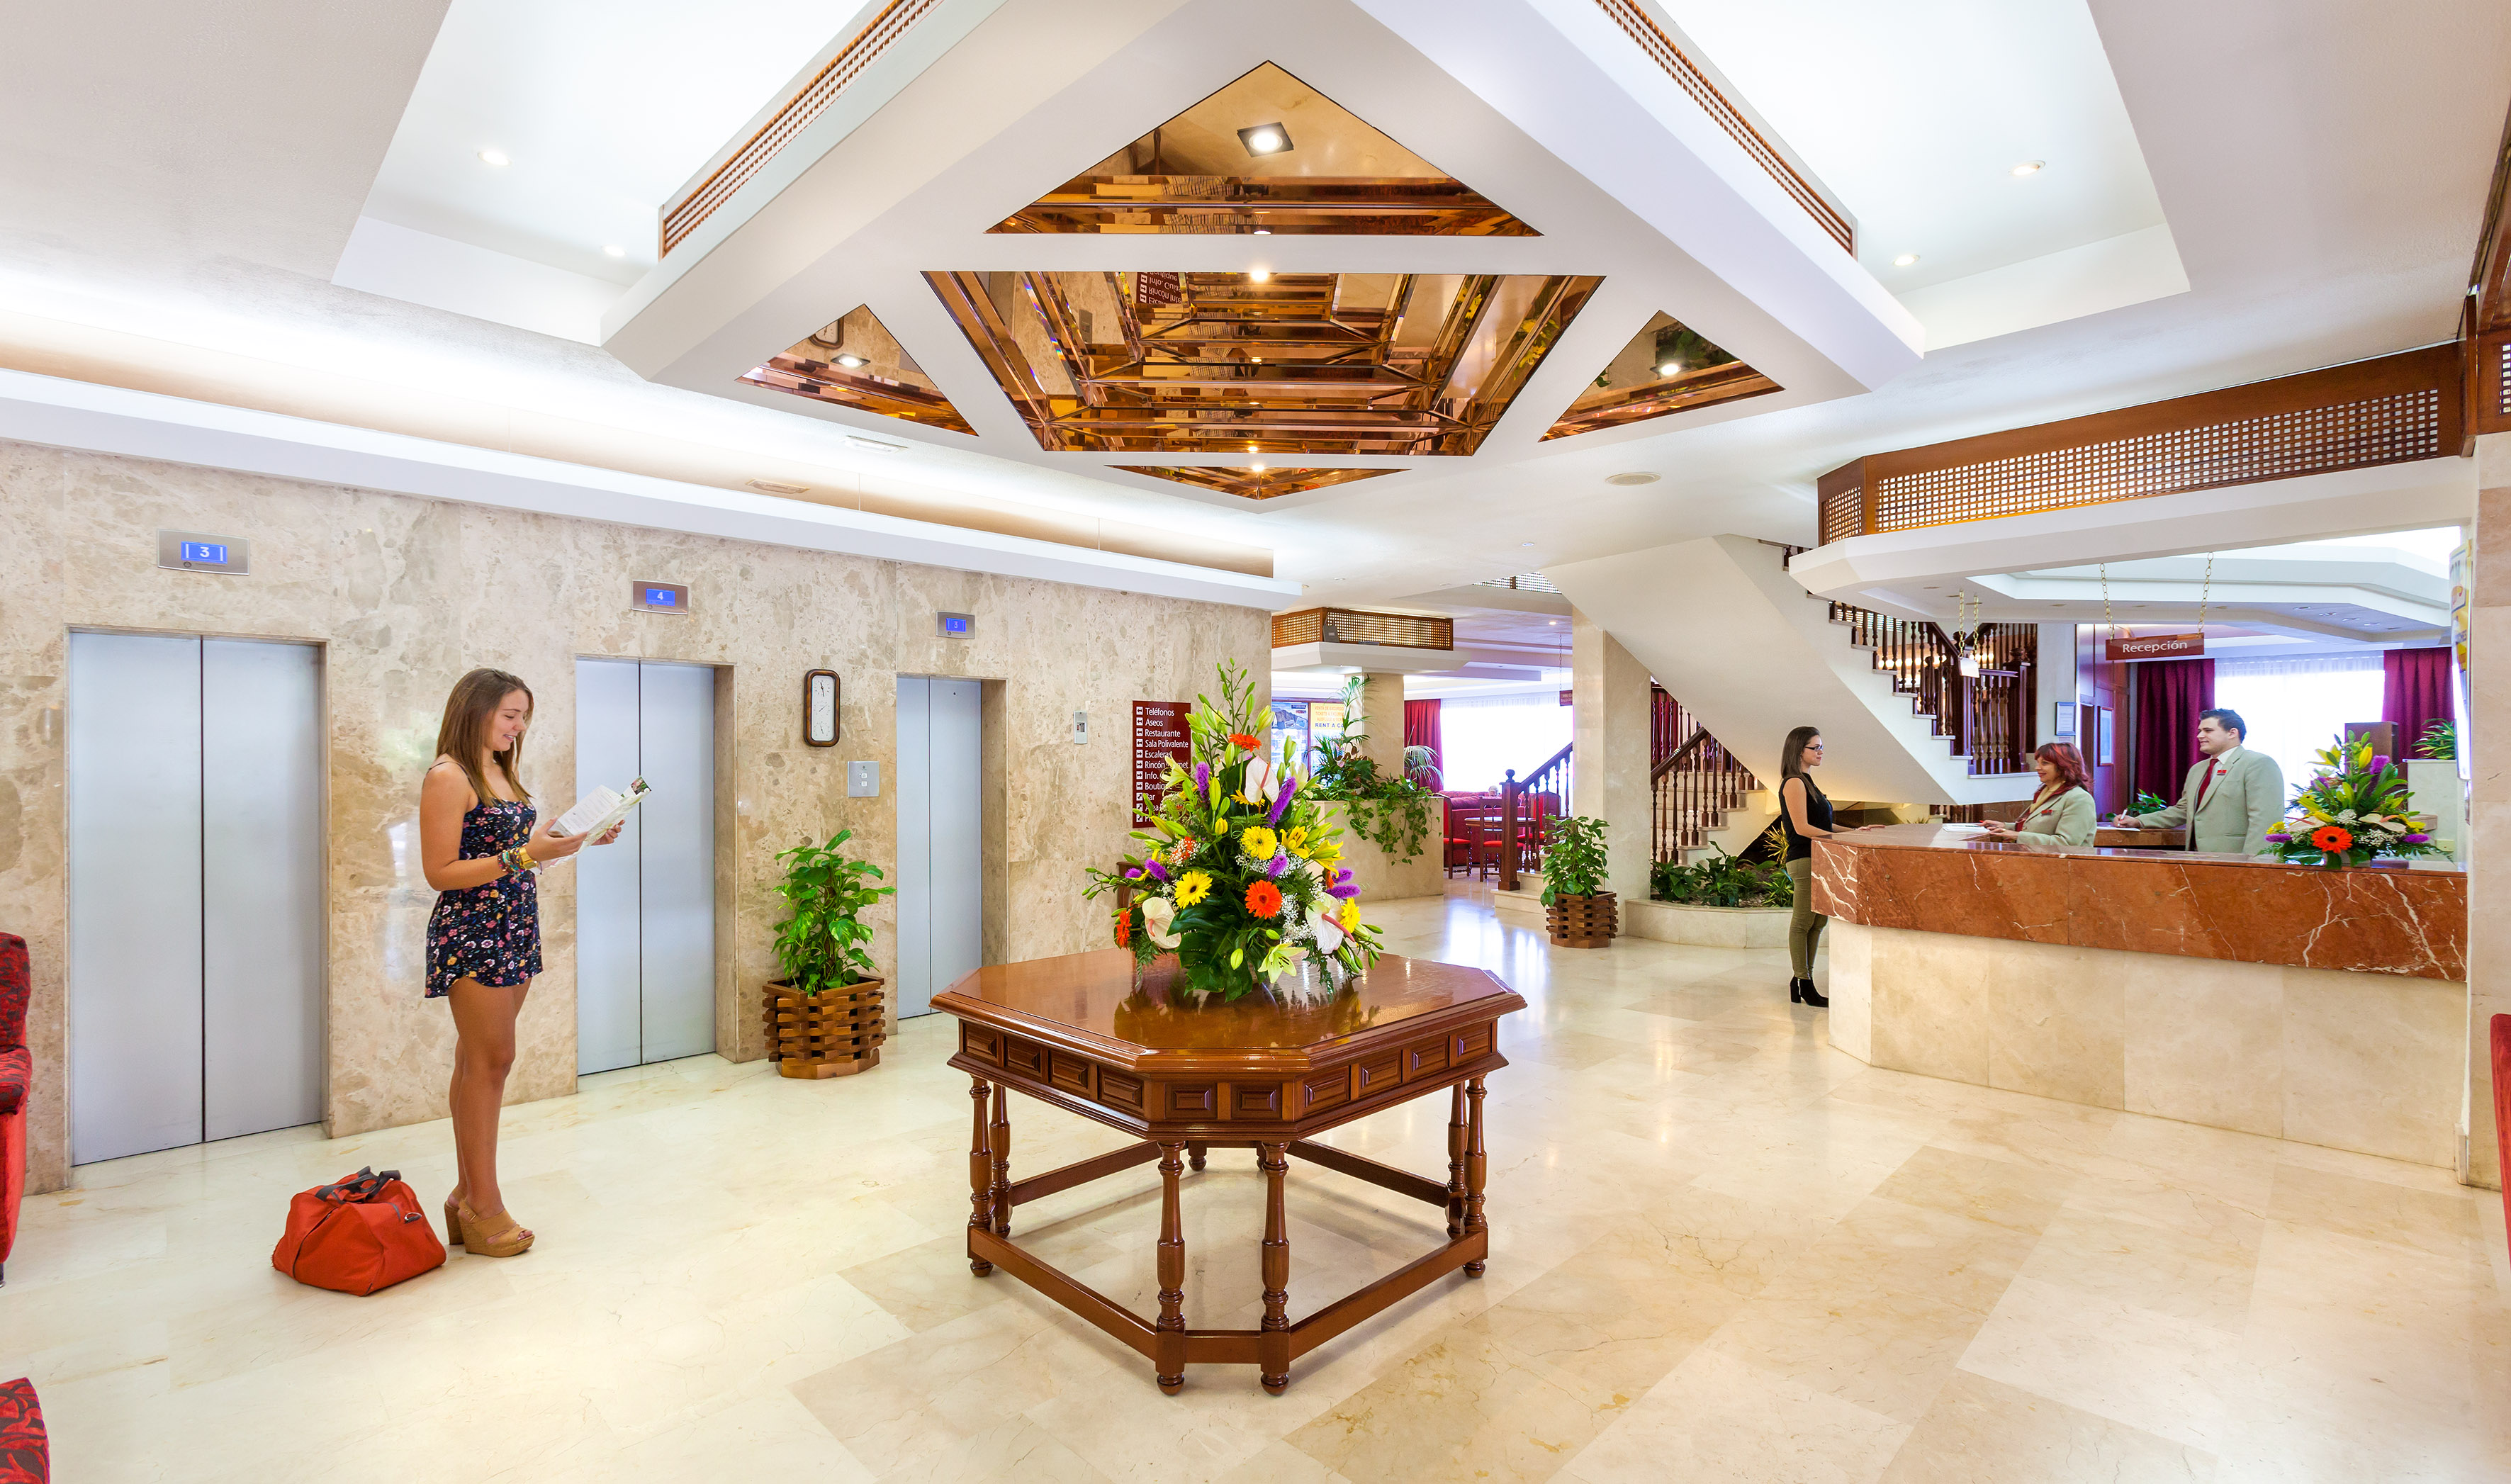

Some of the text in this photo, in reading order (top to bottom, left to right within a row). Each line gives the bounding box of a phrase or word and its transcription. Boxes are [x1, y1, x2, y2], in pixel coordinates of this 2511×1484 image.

[199, 546, 210, 558] 3
[657, 591, 663, 600] 4
[2122, 640, 2188, 653] Recepción
[1145, 707, 1174, 716] Teléfonos
[1145, 739, 1157, 748] Sala
[1145, 771, 1159, 780] Info.
